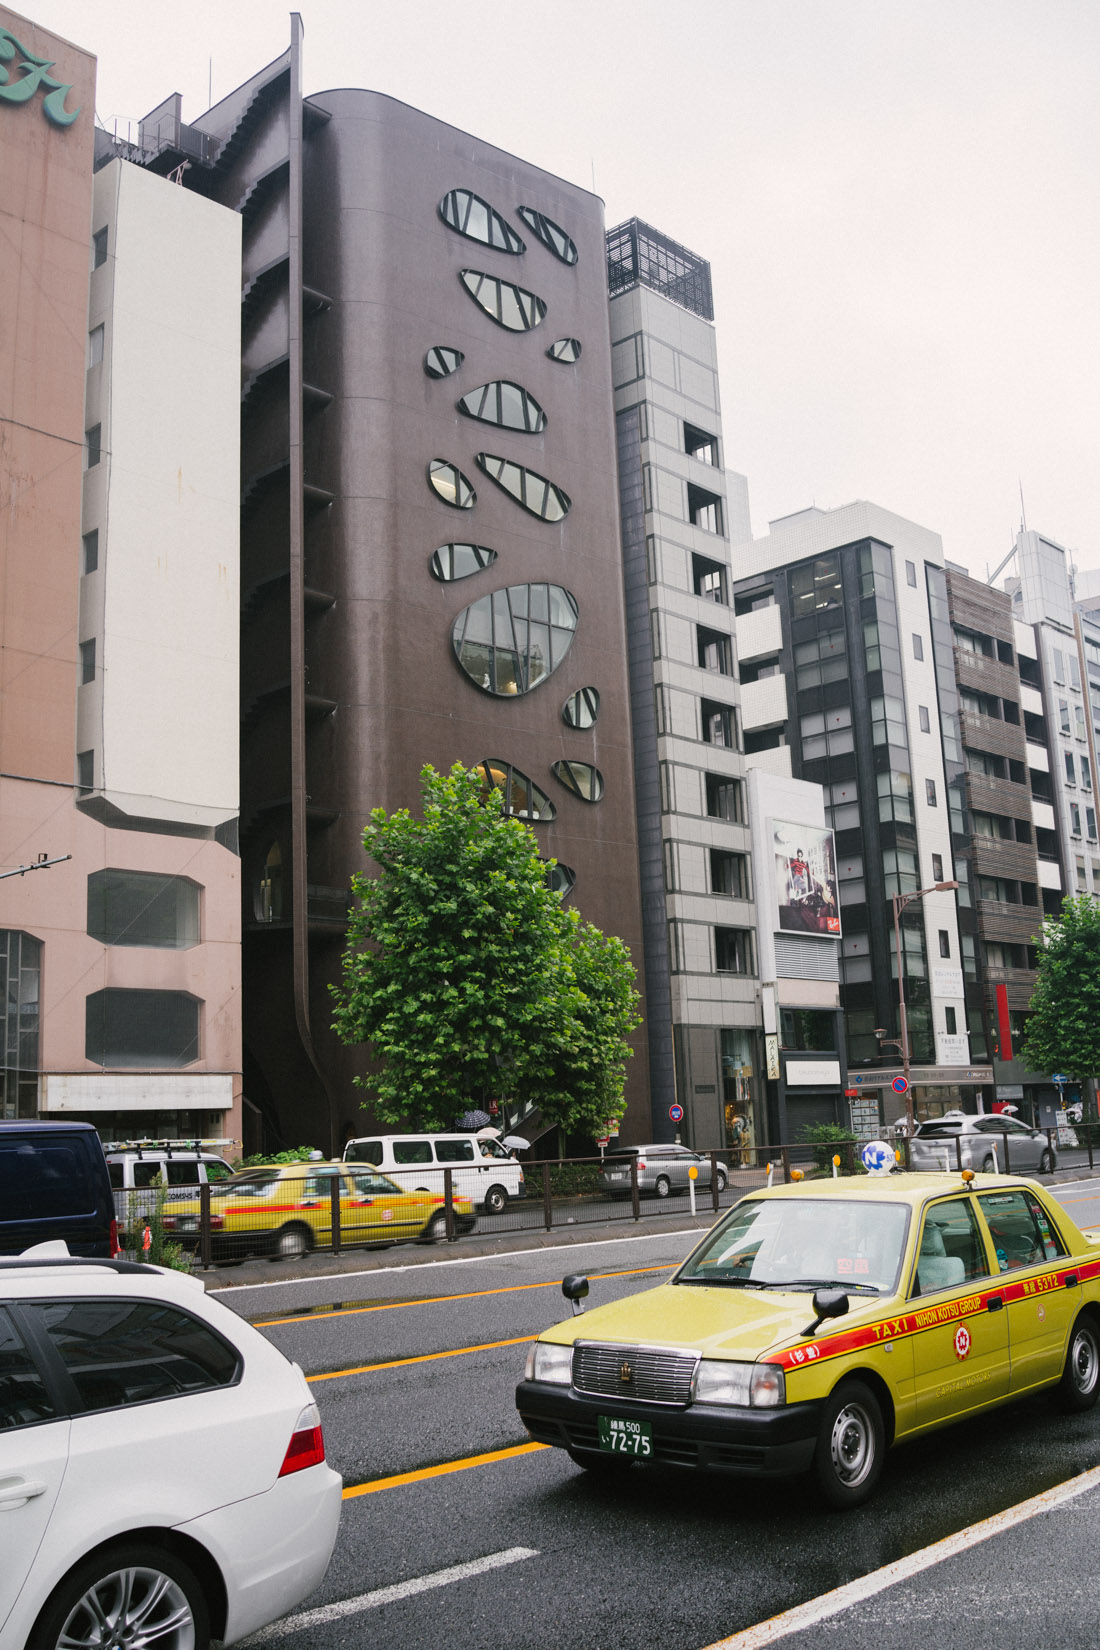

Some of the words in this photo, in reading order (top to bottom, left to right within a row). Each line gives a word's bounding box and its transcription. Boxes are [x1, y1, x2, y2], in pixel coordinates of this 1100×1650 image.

[768, 1039, 777, 1077] MALAIKA
[1037, 1274, 1059, 1291] 5372
[872, 1319, 908, 1340] TAXI
[914, 1313, 938, 1328] NIHON
[937, 1304, 960, 1322] KOTSU
[959, 1297, 982, 1315] GROUP
[935, 1382, 964, 1399] CAPITAL
[964, 1371, 991, 1389] MOTORS
[625, 1421, 640, 1432] 500
[601, 1434, 610, 1443] い
[610, 1431, 651, 1455] 72-75
